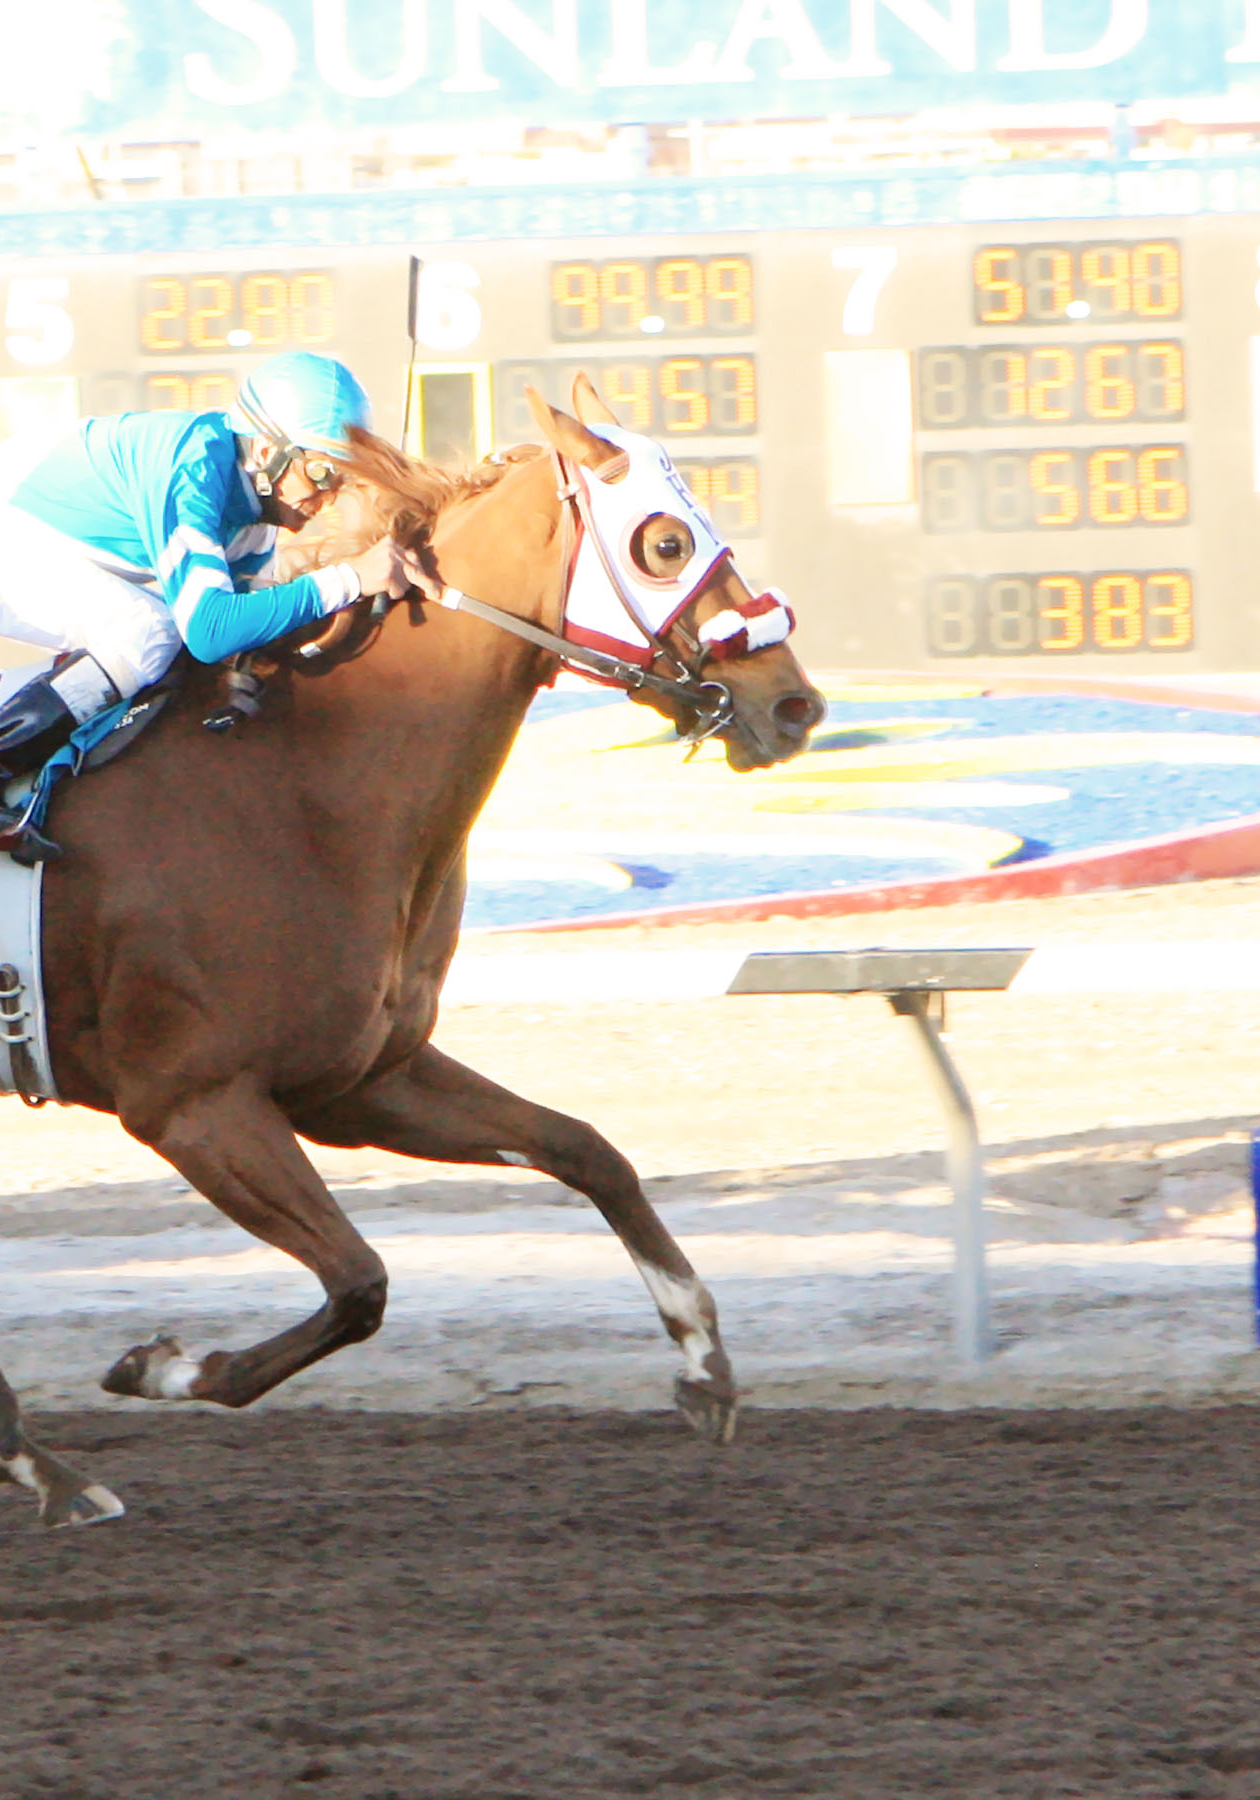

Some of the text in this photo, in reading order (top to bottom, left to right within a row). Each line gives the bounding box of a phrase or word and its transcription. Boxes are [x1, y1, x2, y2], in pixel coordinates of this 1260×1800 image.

[183, 0, 1148, 105] SUNLAND
[5, 277, 75, 365] 5
[139, 272, 336, 352] 22.80
[416, 260, 483, 350] 6
[550, 261, 754, 334] 99.99
[831, 245, 900, 335] 7
[973, 243, 1182, 324] 51.40
[601, 358, 758, 433] 457
[1006, 342, 1186, 422] 1267
[1027, 447, 1189, 527] 566
[1037, 573, 1196, 652] 383
